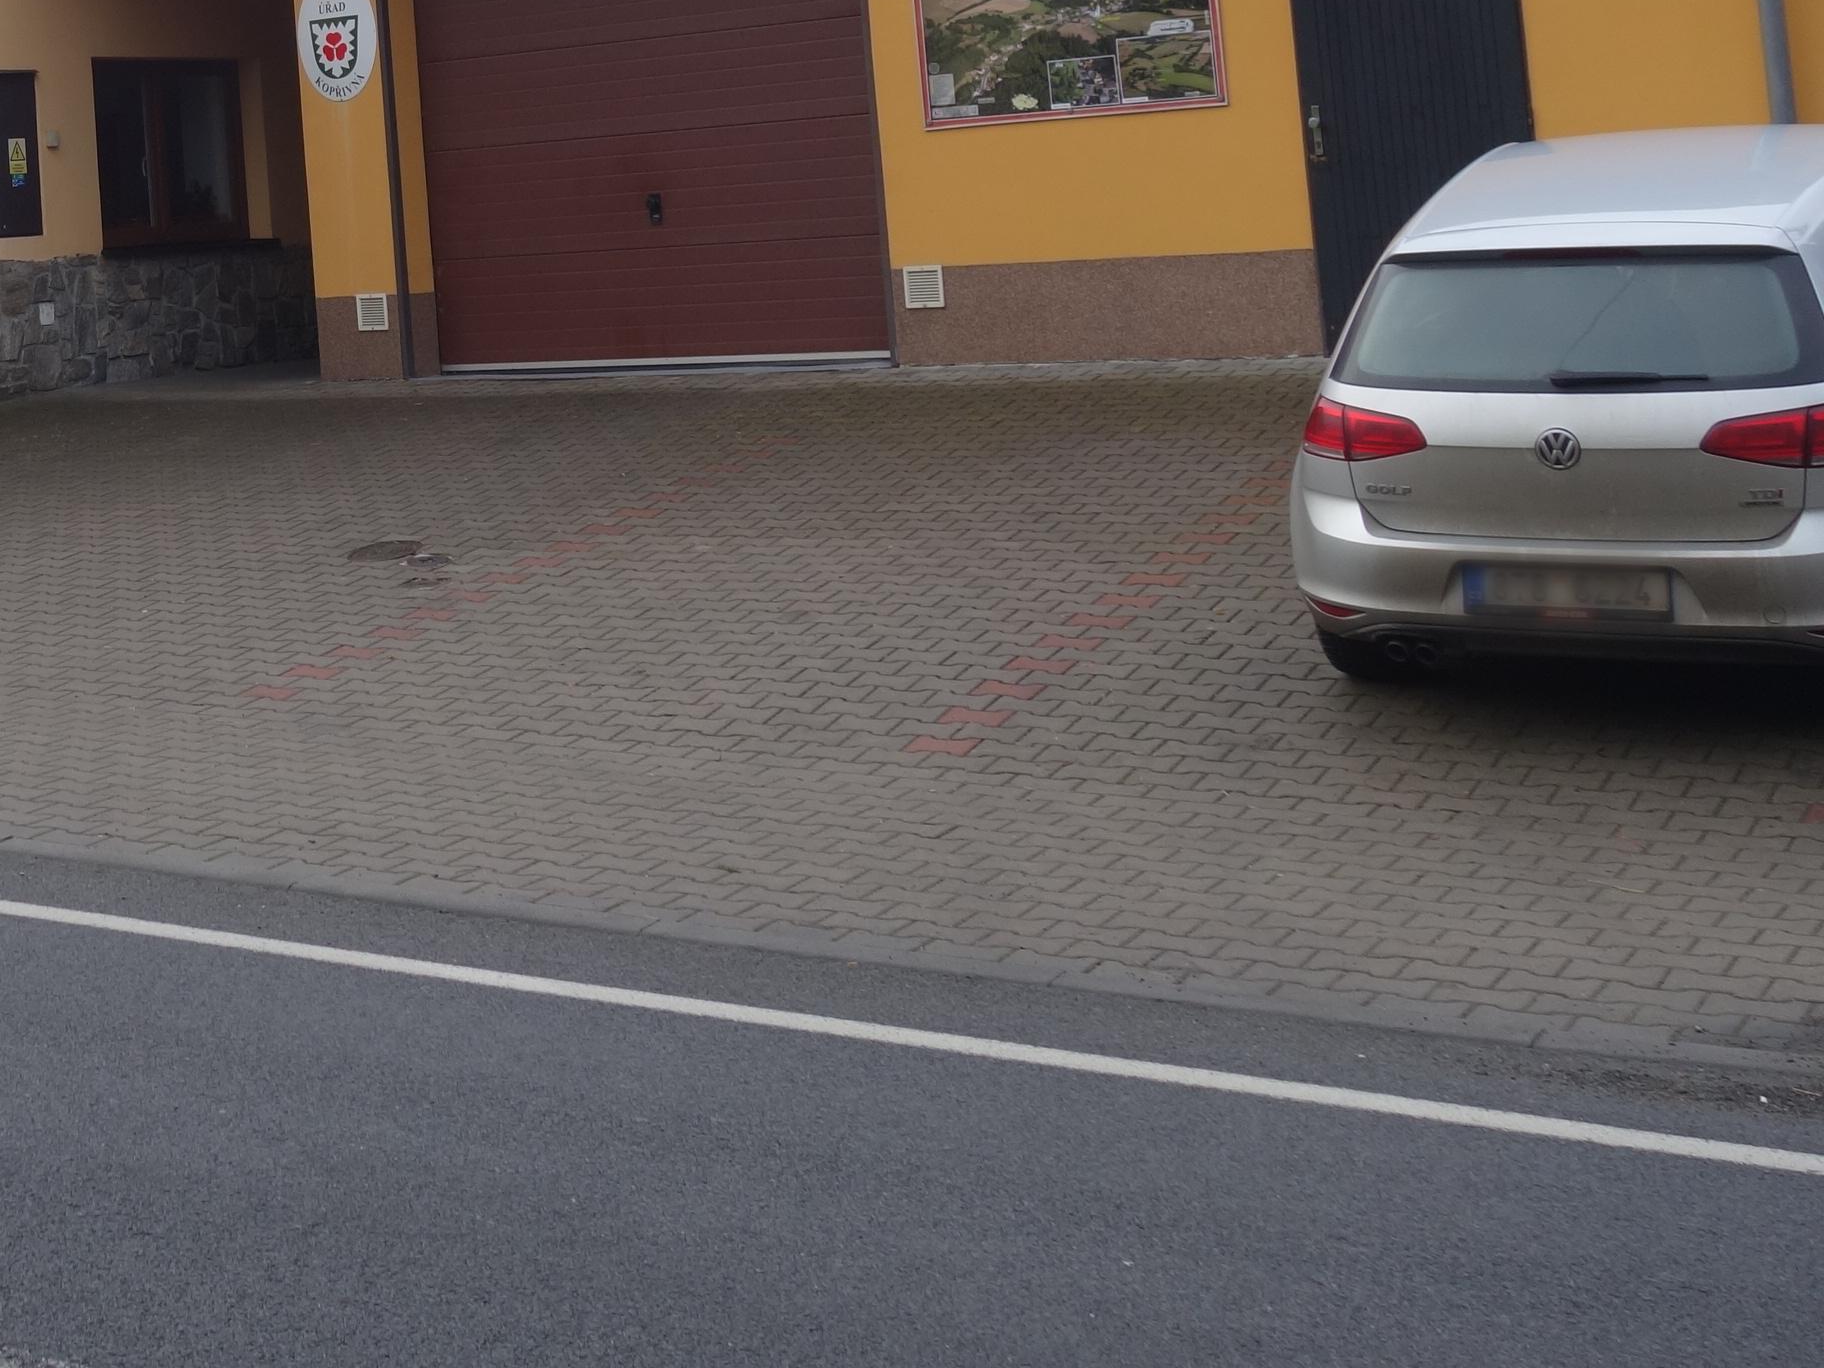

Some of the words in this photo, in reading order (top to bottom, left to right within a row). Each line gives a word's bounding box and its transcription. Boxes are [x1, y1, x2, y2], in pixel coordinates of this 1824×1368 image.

[318, 1, 346, 15] ÚŘAD
[314, 73, 365, 98] KOPŘIVNÁ
[1365, 482, 1413, 496] GOLF
